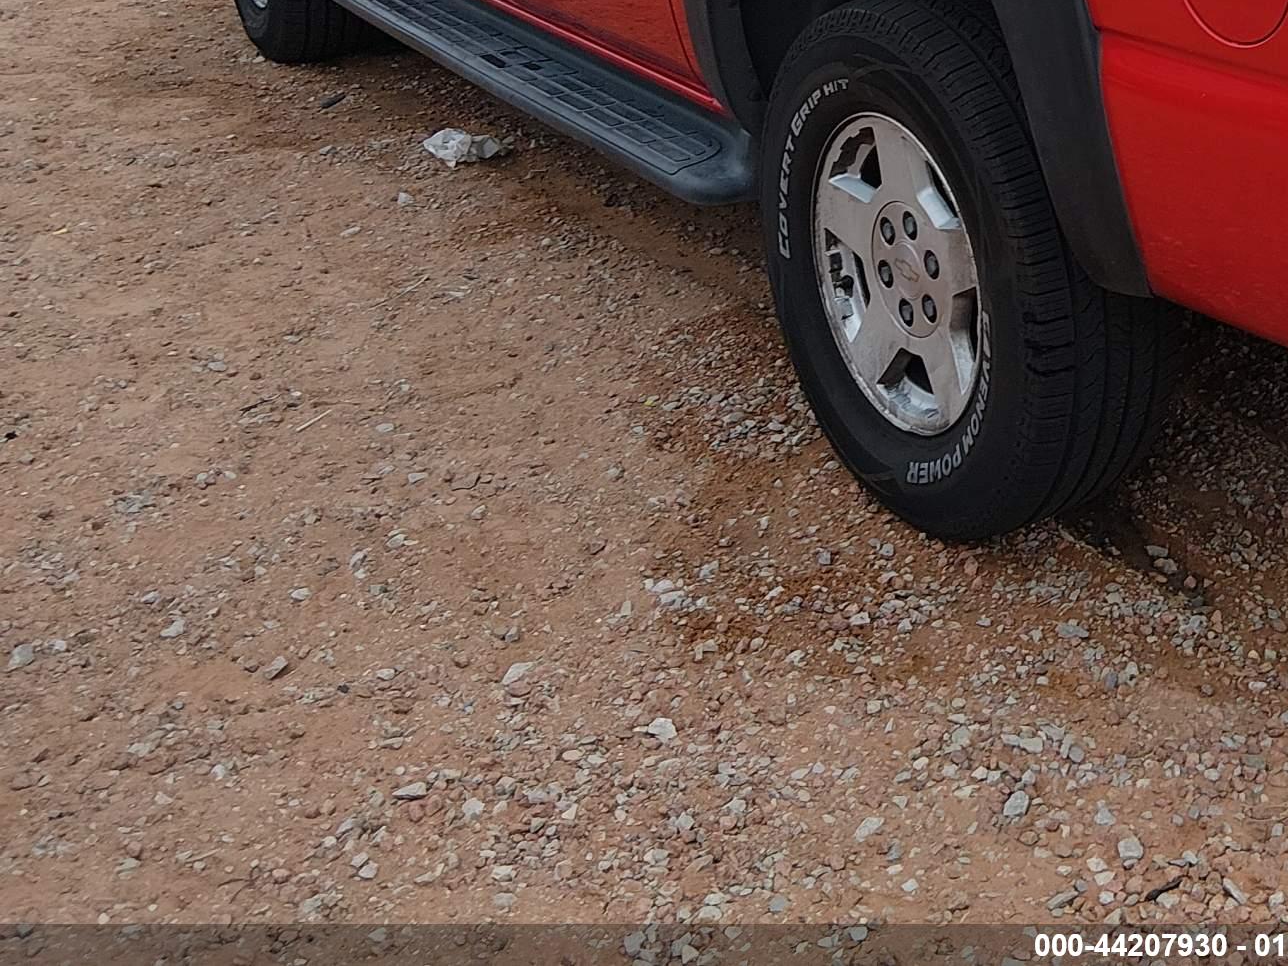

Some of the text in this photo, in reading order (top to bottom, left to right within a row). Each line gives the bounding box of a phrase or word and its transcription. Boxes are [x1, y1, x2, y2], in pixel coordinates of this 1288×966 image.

[777, 134, 795, 260] COVERT
[790, 88, 822, 137] GRIP
[906, 359, 991, 484] VENOM POWER
